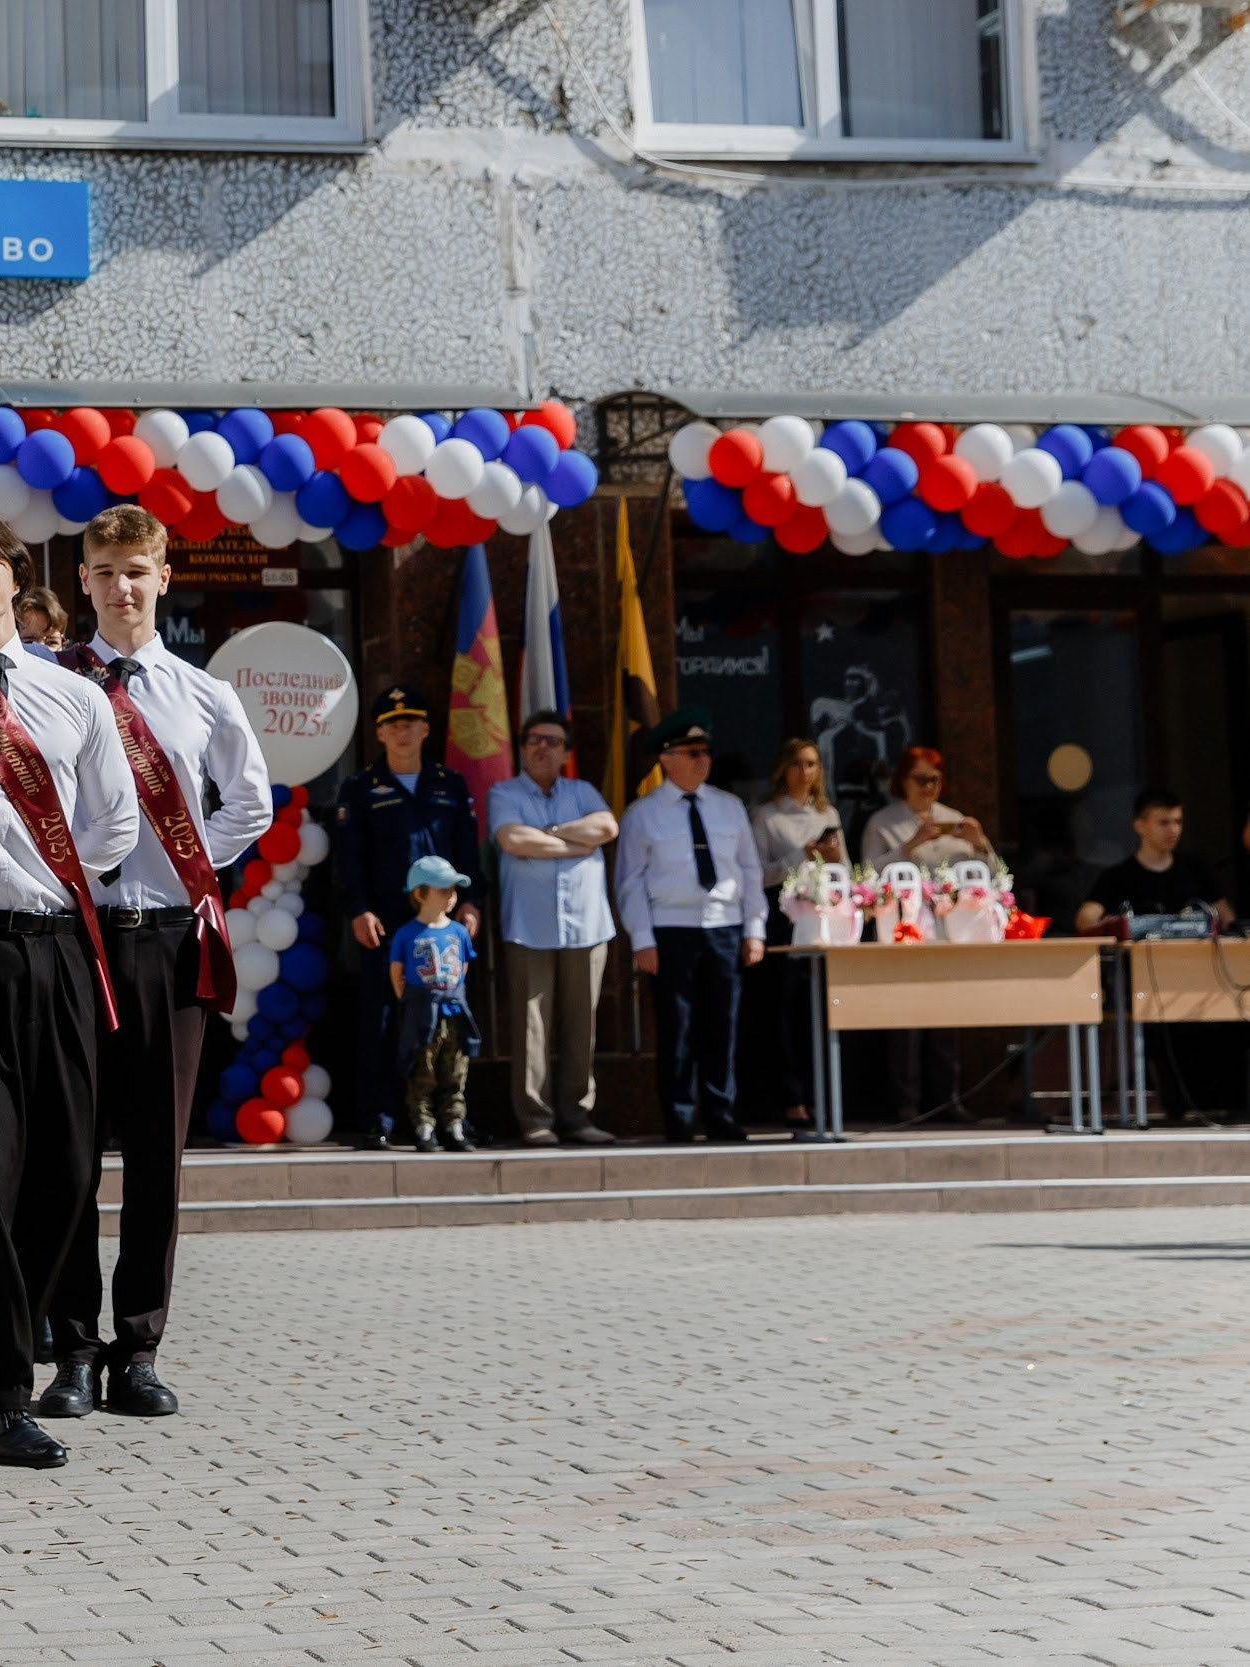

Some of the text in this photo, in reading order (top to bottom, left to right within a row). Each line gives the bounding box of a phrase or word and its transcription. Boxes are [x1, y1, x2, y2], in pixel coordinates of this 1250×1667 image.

[166, 616, 206, 645] Мы
[236, 667, 344, 691] Последний
[259, 689, 327, 710] звонок
[38, 811, 72, 863] 2025
[162, 810, 200, 860] 2025
